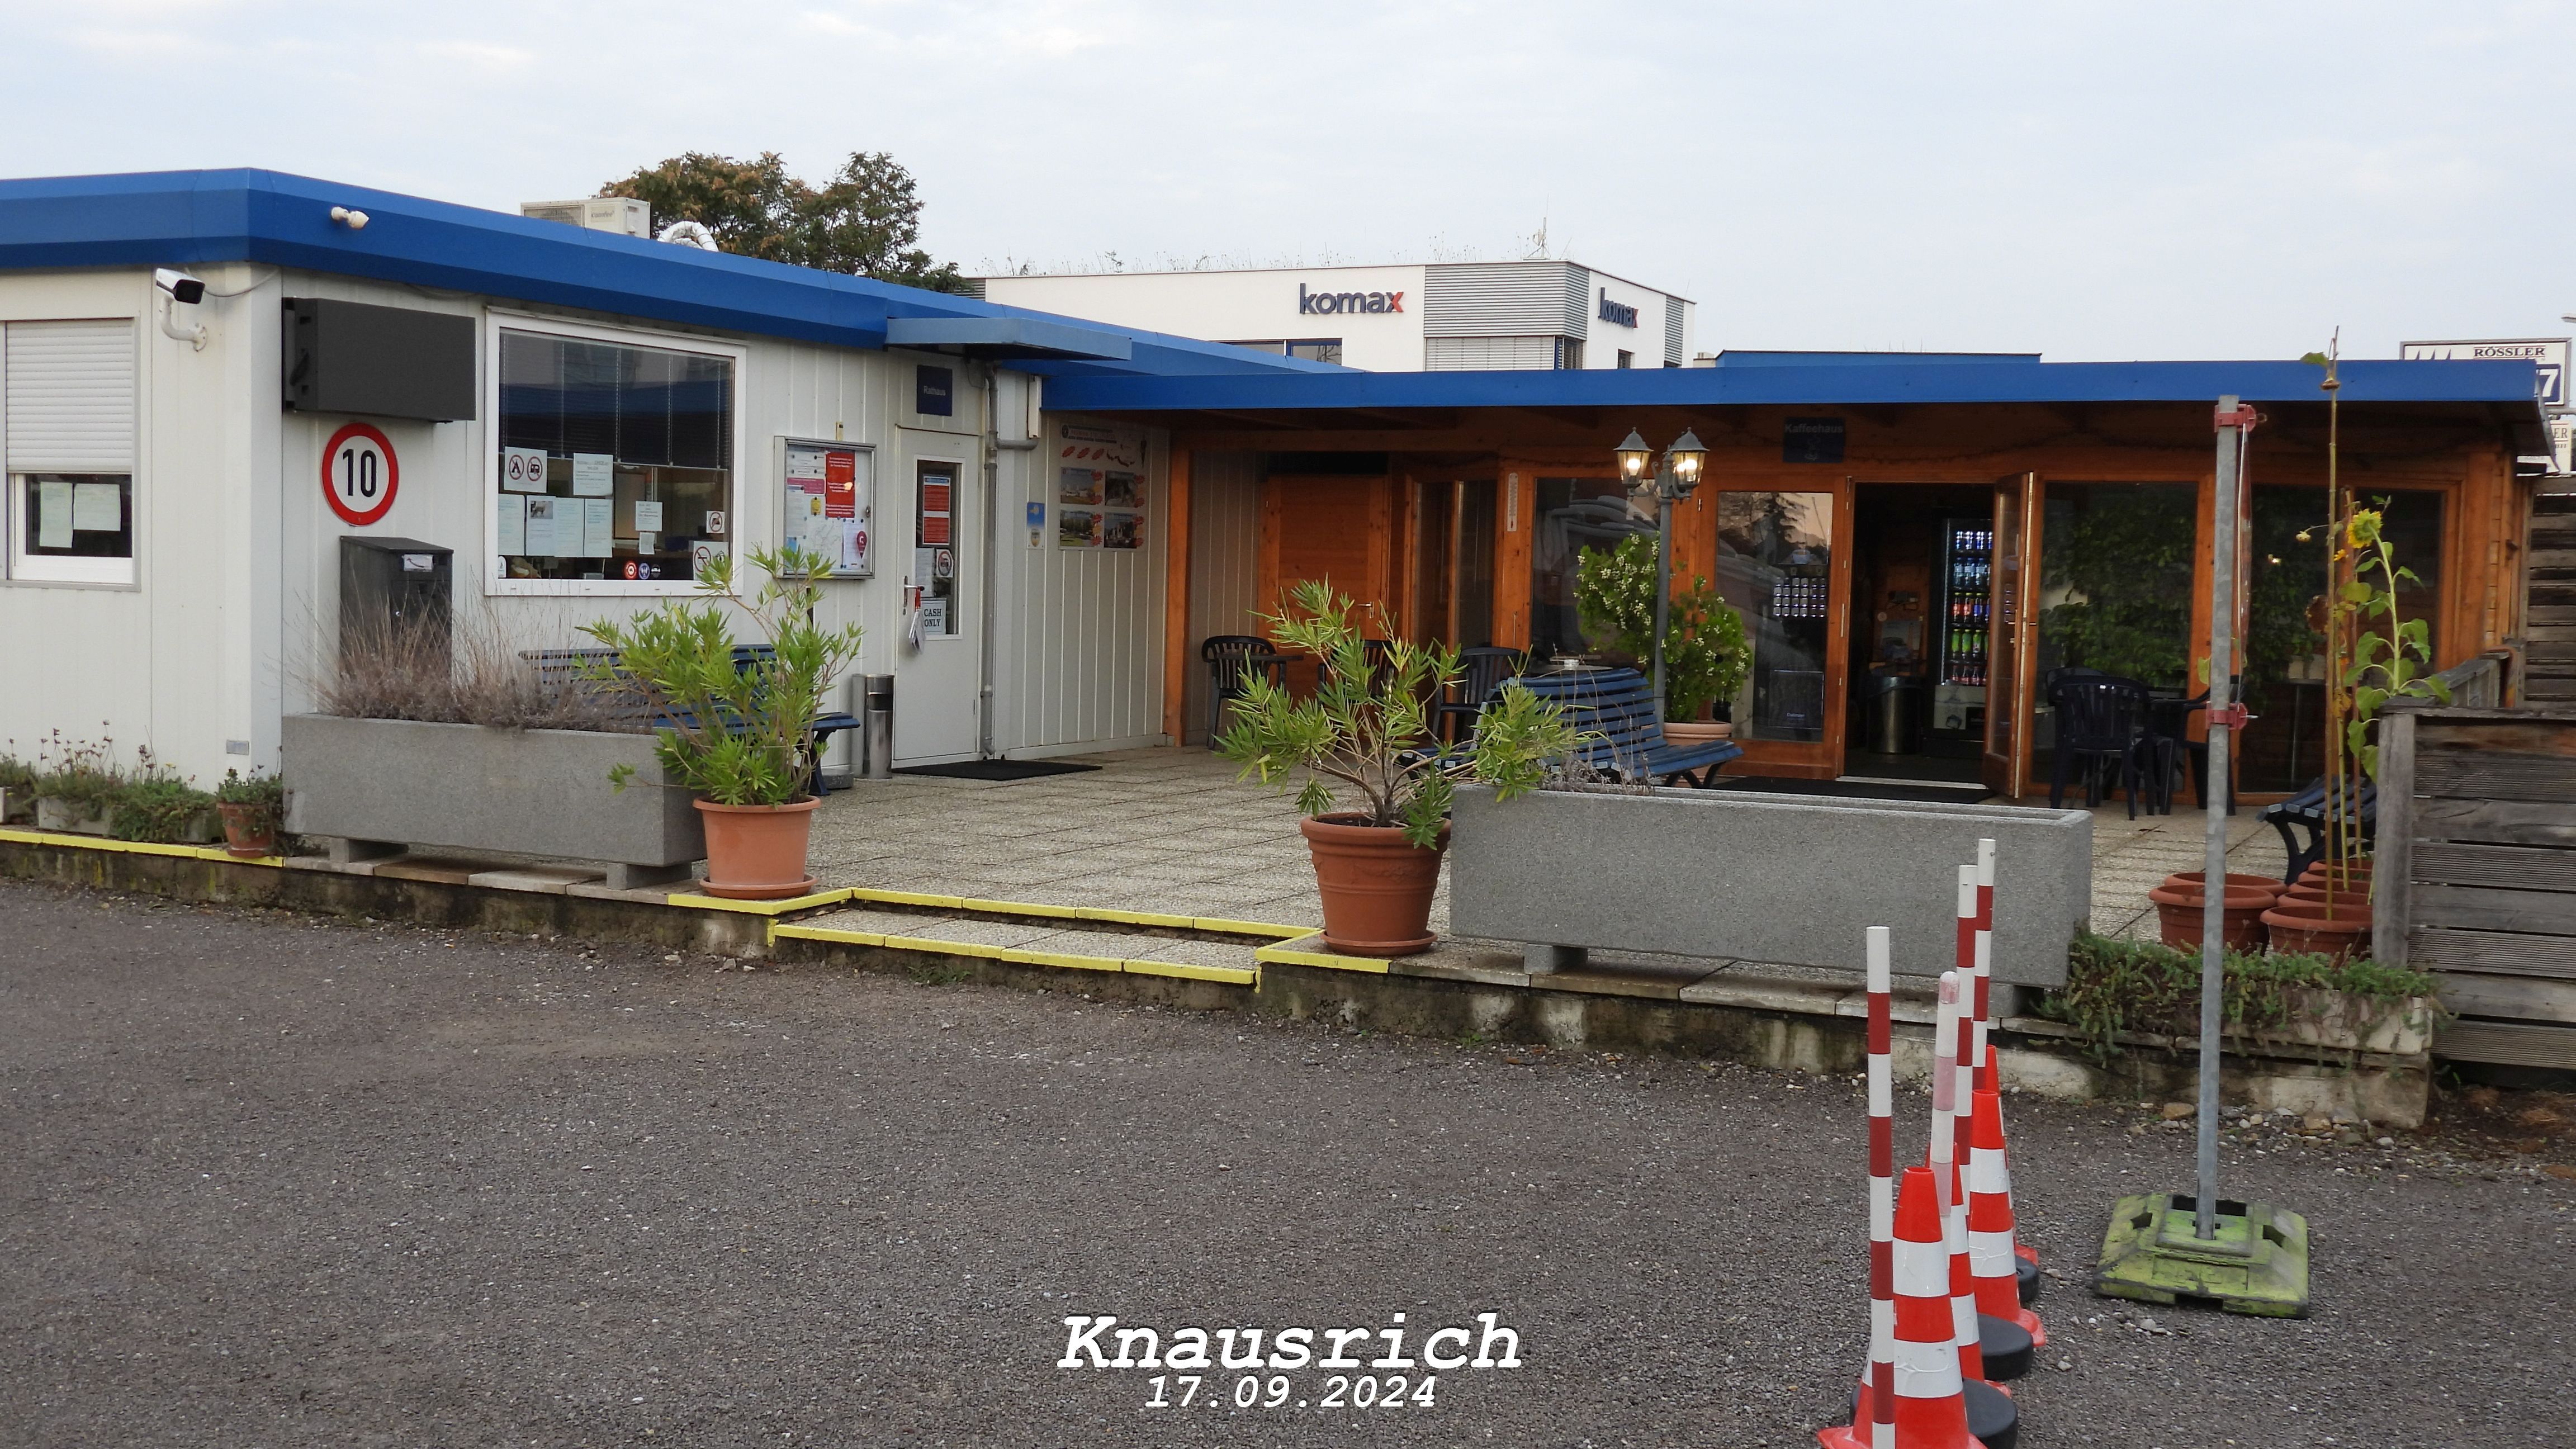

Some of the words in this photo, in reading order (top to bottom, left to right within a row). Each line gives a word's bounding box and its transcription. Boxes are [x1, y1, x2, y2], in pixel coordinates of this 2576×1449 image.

[1300, 283, 1404, 314] komax
[1598, 287, 1639, 328] komax
[2474, 347, 2545, 357] RÖSSLER
[1785, 424, 1843, 433] Kaffeehaus
[2554, 428, 2568, 438] ER
[343, 449, 376, 497] 10
[924, 608, 942, 617] CASH
